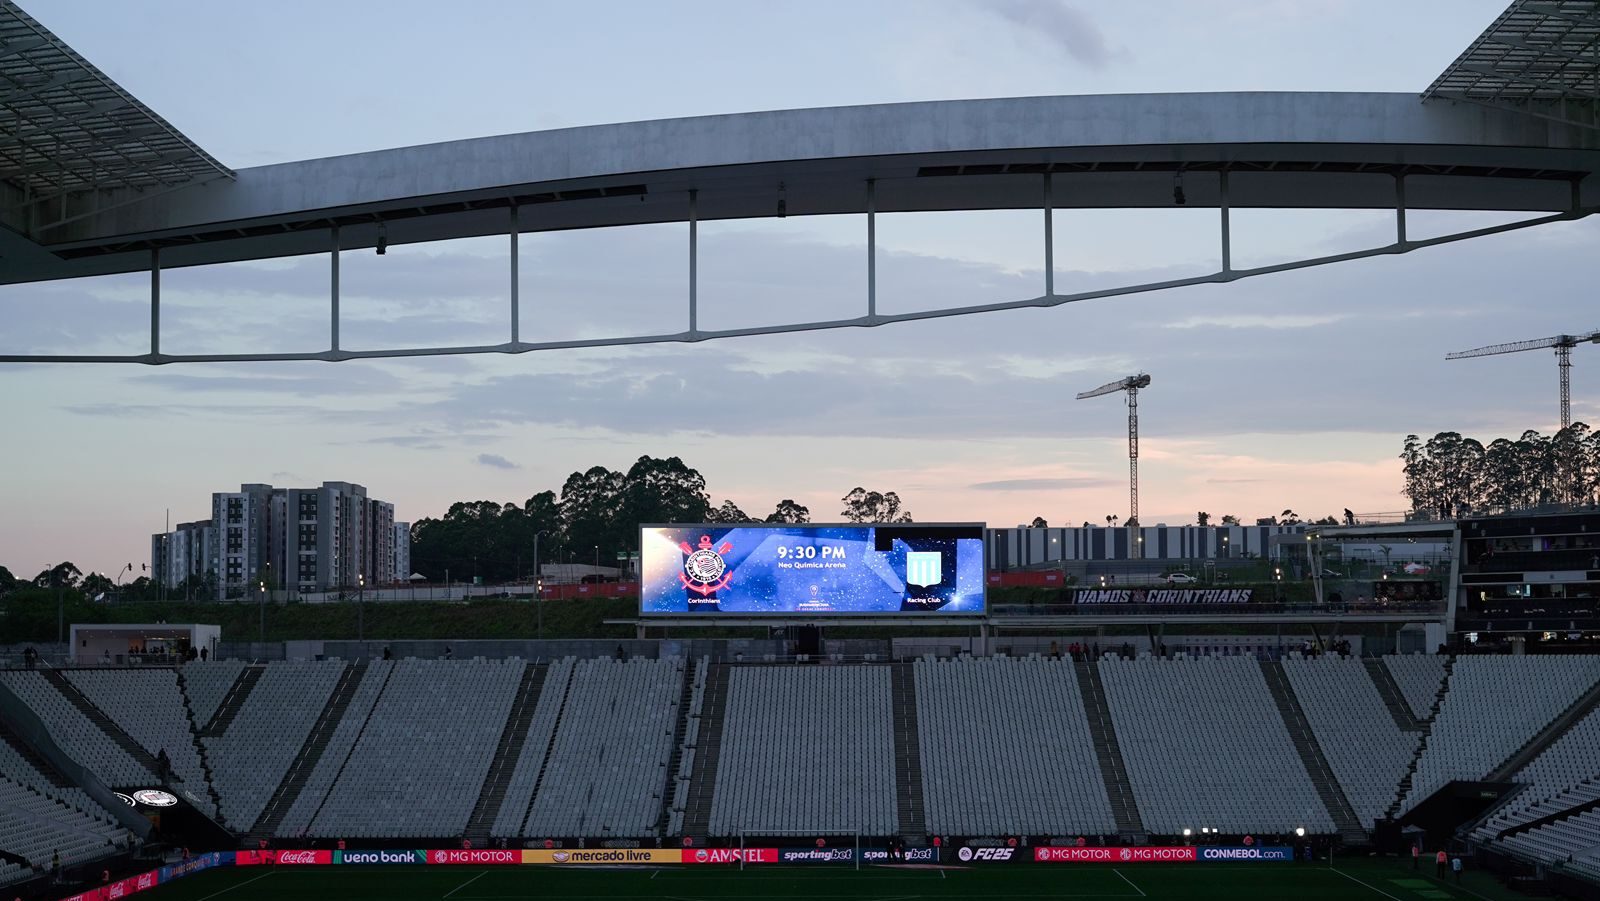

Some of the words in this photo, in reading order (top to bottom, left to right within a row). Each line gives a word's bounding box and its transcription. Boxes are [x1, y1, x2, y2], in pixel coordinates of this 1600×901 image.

[777, 545, 816, 559] 9:30
[821, 545, 846, 559] PM
[778, 561, 793, 569] Neo
[1077, 589, 1131, 603] VAMOS
[1146, 588, 1252, 603] CORINTHIANS
[344, 853, 379, 863] ueno
[380, 850, 415, 863] bank
[450, 851, 468, 862] MG
[470, 851, 513, 862] MOTOR
[571, 850, 624, 861] mercado
[626, 850, 651, 861] livre
[710, 849, 764, 862] AMSTEL
[784, 848, 852, 861] sportingbet
[973, 848, 1015, 860] FC25
[1052, 849, 1069, 859] MG
[1071, 849, 1111, 859] MOTOR
[1134, 849, 1151, 859] MG
[1152, 849, 1193, 859] MOTOR
